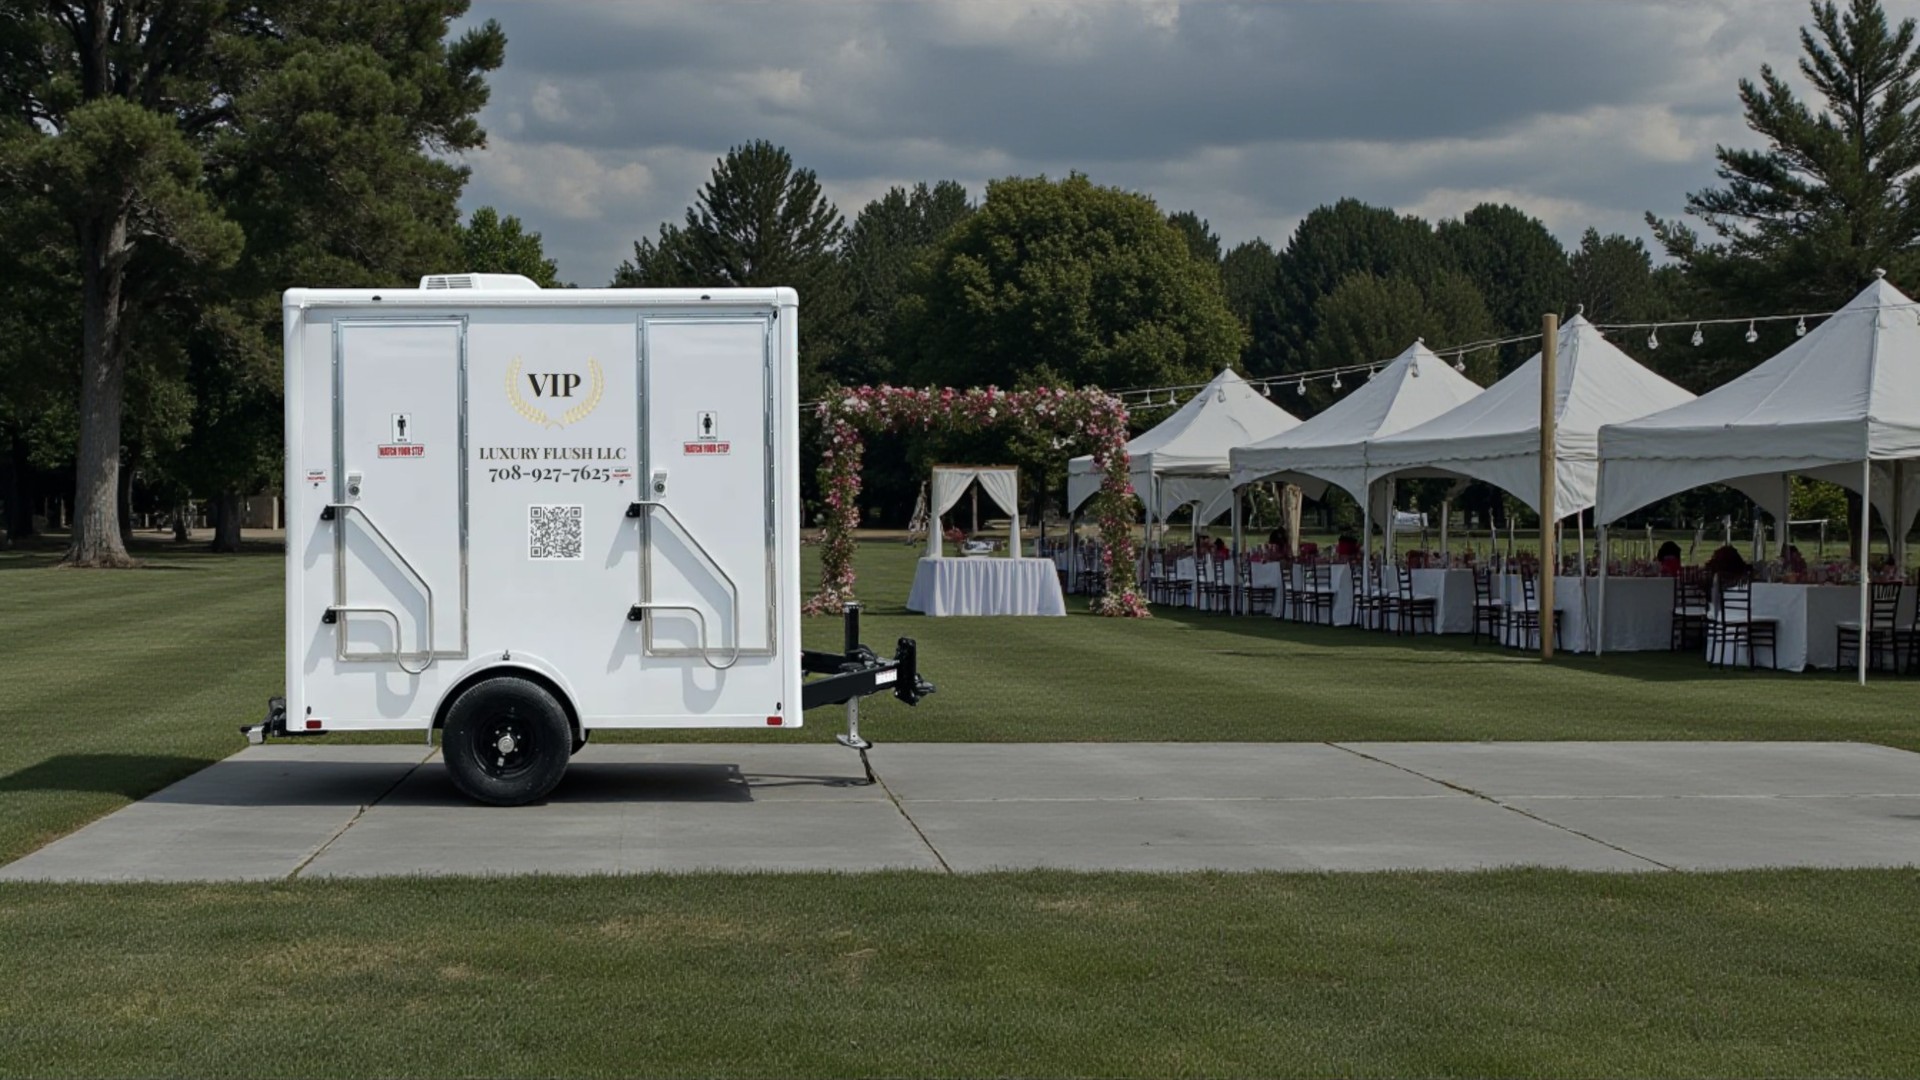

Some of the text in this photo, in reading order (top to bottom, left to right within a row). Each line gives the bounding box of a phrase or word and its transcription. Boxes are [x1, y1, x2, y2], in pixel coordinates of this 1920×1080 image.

[527, 373, 582, 398] VIP
[411, 446, 424, 456] STEP
[479, 447, 627, 460] LUXURY FLUSH LLC
[717, 443, 729, 453] STEP
[488, 464, 611, 483] 708-927-7625
